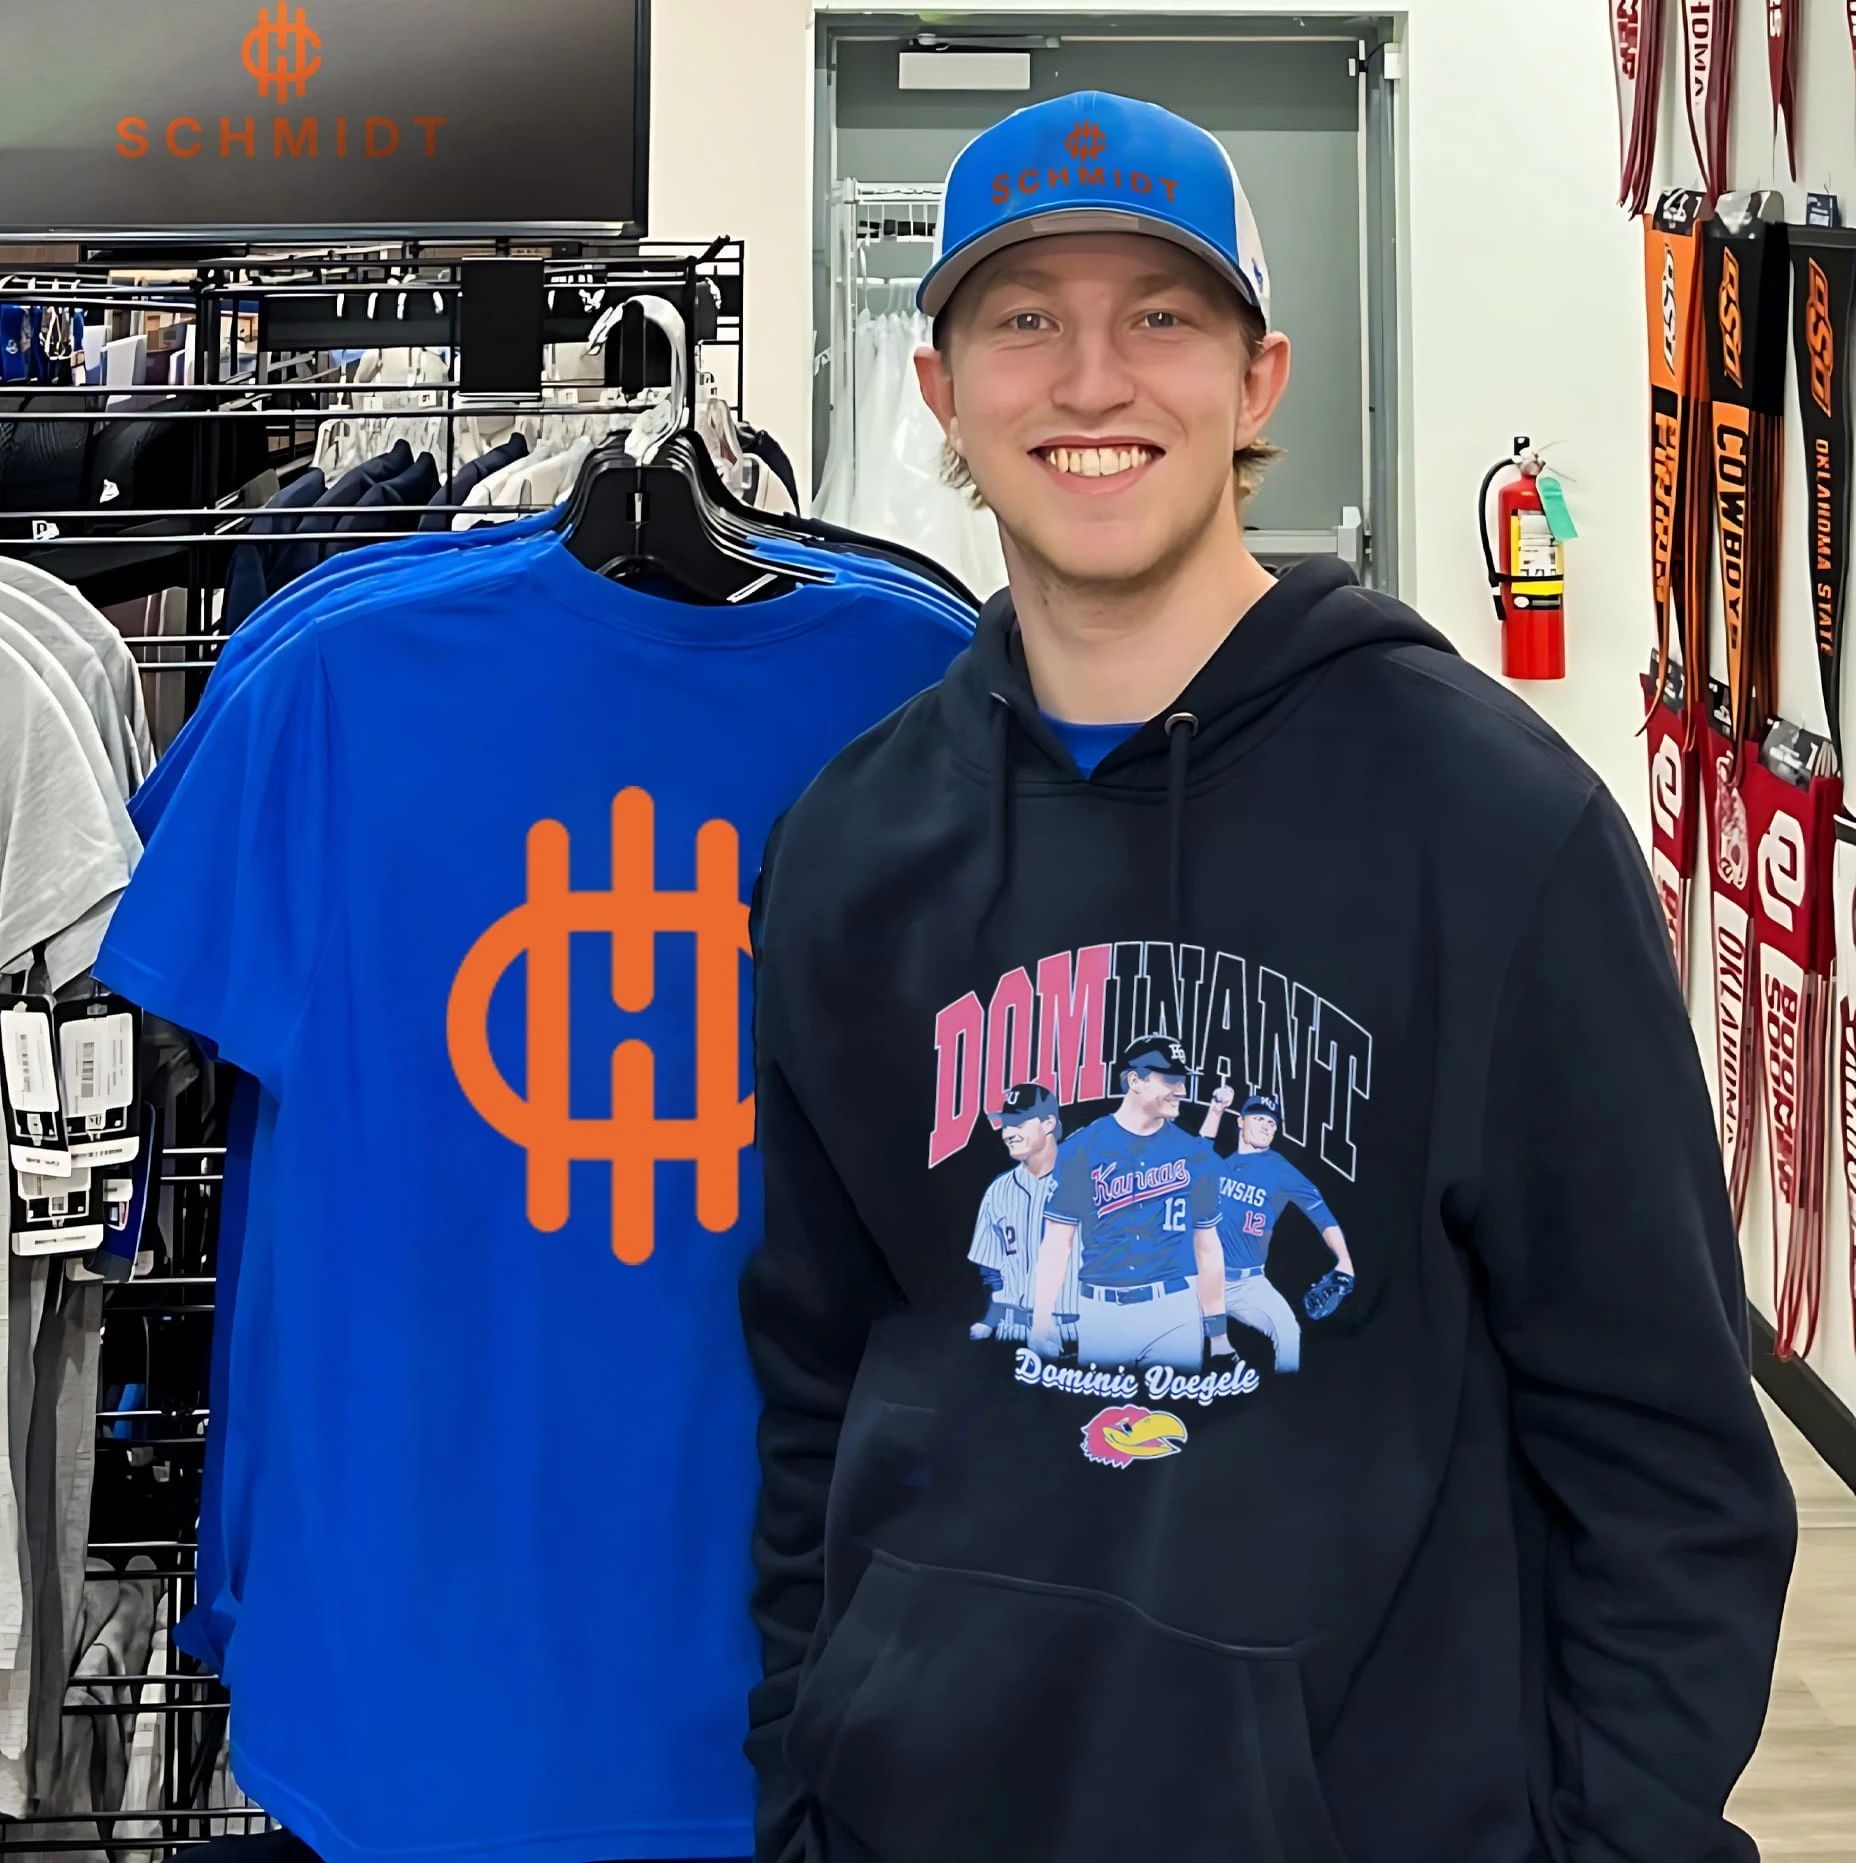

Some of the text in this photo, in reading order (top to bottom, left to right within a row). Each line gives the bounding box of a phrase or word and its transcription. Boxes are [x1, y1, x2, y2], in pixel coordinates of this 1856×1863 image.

[115, 115, 448, 160] SCHMIDT
[991, 166, 1180, 205] SCHMIDT
[1718, 926, 1745, 1144] OKLAHOMA
[928, 940, 1374, 1183] DOMINANT
[1091, 1158, 1191, 1210] Kansas
[1162, 1196, 1187, 1232] 12
[1242, 1209, 1267, 1237] 12
[1013, 1347, 1260, 1406] Dominic Voegele
